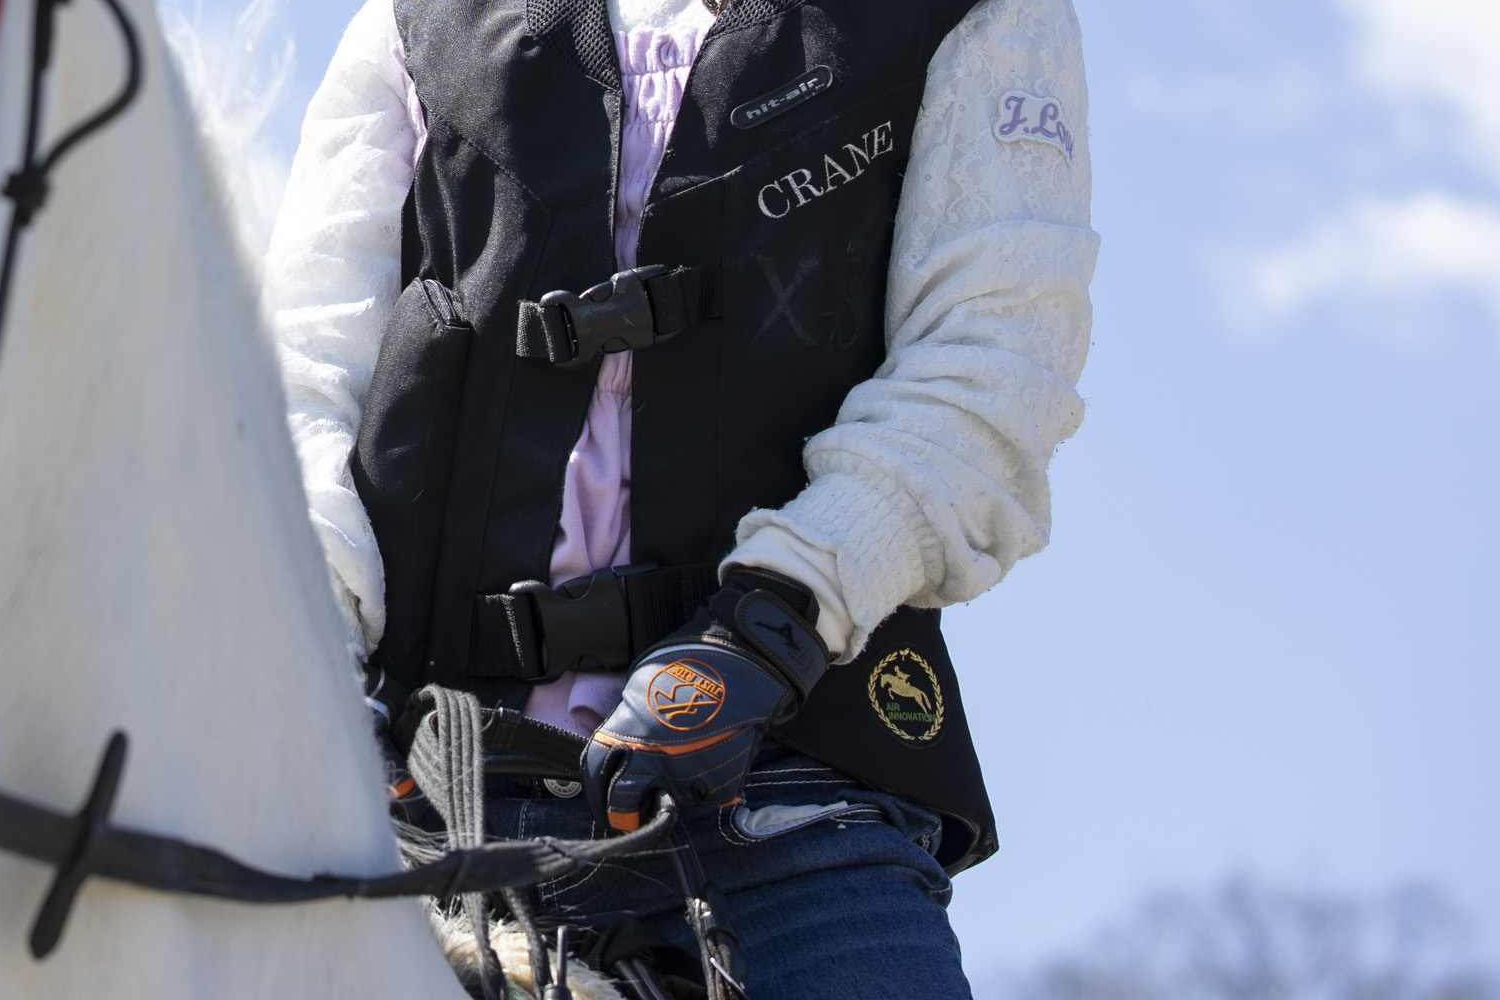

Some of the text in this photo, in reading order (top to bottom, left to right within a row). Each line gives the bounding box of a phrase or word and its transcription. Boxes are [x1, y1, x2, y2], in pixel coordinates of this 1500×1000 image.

[744, 77, 818, 119] hit-air
[757, 121, 893, 219] CRANE
[670, 665, 722, 696] JUST RIDE
[886, 702, 900, 711] AIR
[888, 711, 937, 722] INNOVATION
